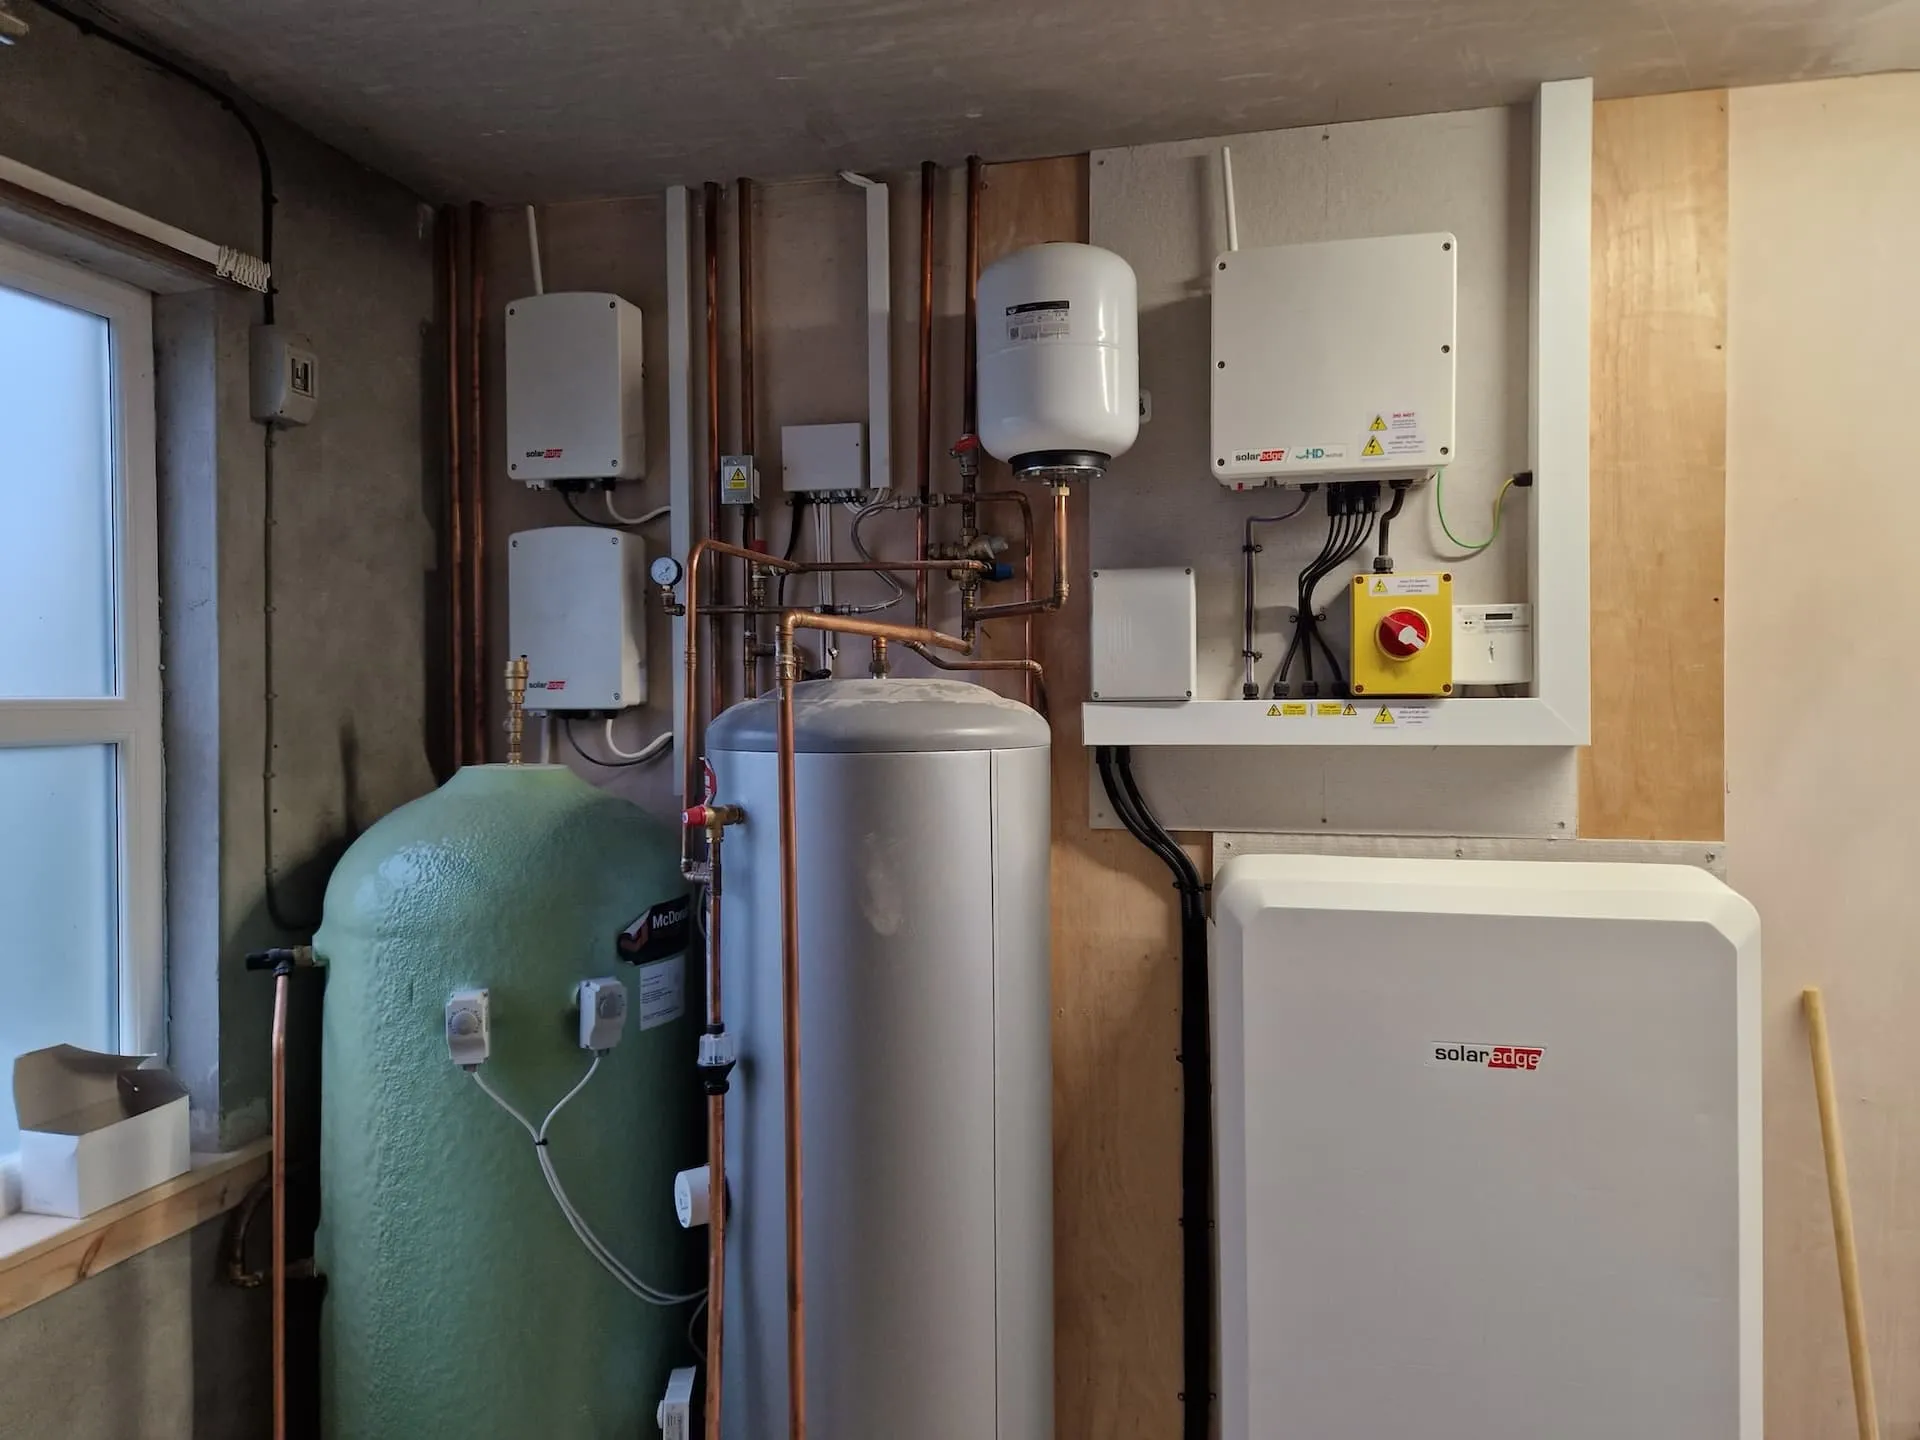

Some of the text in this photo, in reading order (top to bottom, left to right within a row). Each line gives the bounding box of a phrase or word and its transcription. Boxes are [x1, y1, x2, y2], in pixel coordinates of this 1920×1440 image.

[1235, 450, 1285, 462] solaredge
[1306, 448, 1324, 459] HD
[1435, 1045, 1542, 1070] solaredge
